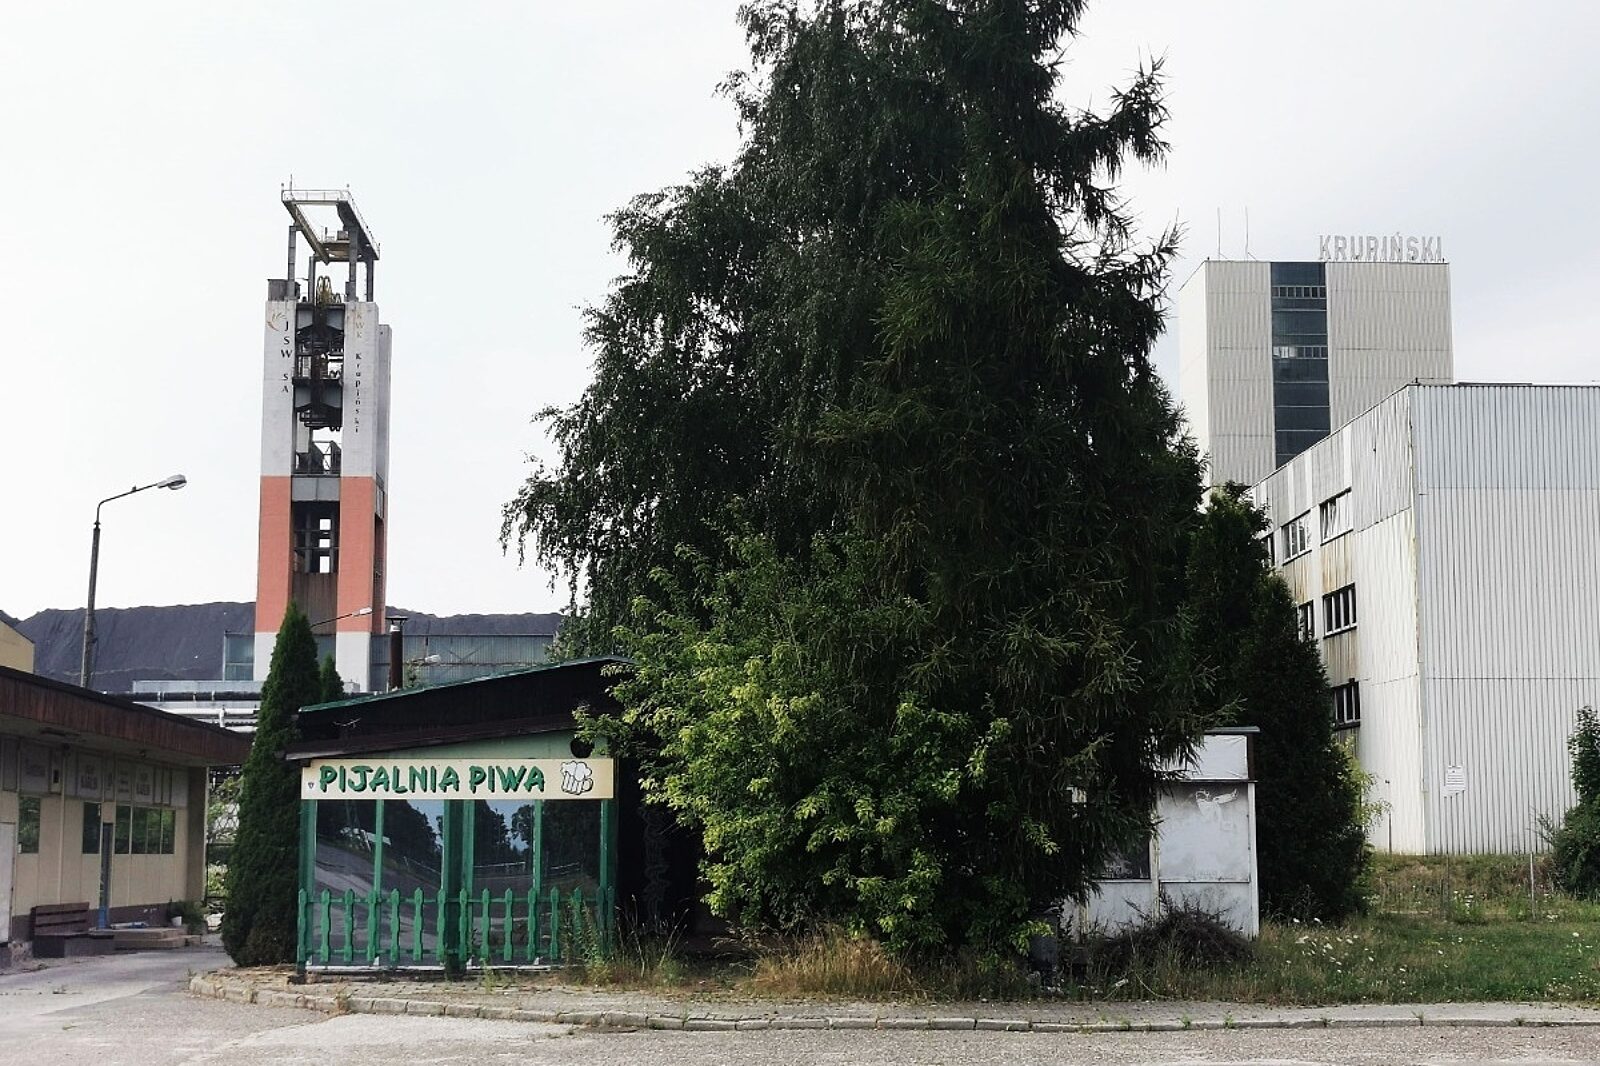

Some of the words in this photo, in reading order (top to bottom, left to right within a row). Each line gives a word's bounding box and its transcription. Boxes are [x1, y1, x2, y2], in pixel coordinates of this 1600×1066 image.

[280, 320, 293, 358] JSW
[281, 373, 290, 393] SA
[319, 765, 460, 794] PIJALNIA
[468, 765, 545, 794] PIWA
